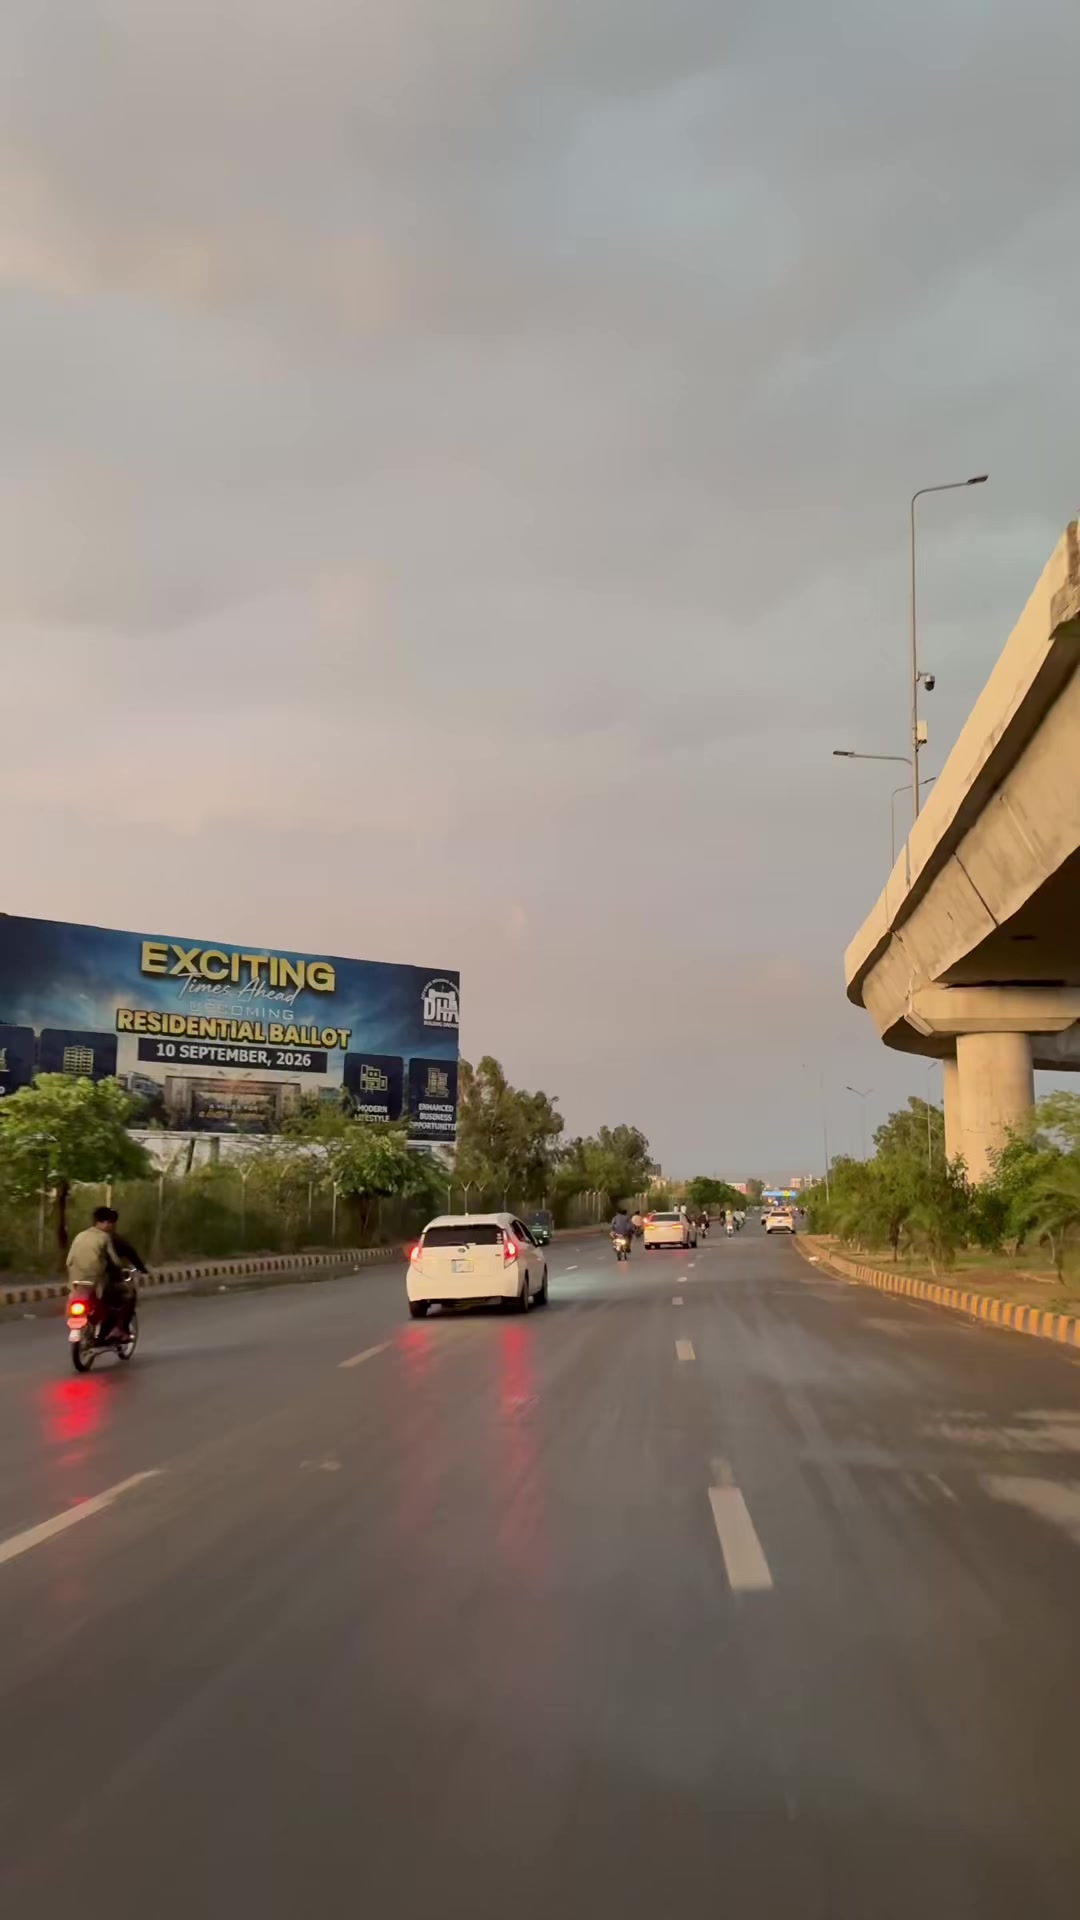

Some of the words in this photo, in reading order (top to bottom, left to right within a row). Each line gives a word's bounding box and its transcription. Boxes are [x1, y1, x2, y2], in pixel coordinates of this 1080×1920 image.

[141, 940, 336, 992] EXCITING
[178, 972, 231, 1000] Times
[237, 976, 303, 1007] Ahead
[423, 997, 459, 1023] DHA
[117, 1008, 266, 1042] RESIDENTIAL
[268, 1023, 351, 1049] BALLOT
[156, 1043, 176, 1057] 10
[179, 1045, 272, 1066] SEPTEMBER,
[276, 1052, 312, 1067] 2026
[357, 1104, 388, 1113] MODERN
[418, 1103, 454, 1112] ENHANCED
[419, 1112, 453, 1121] BUSINESS
